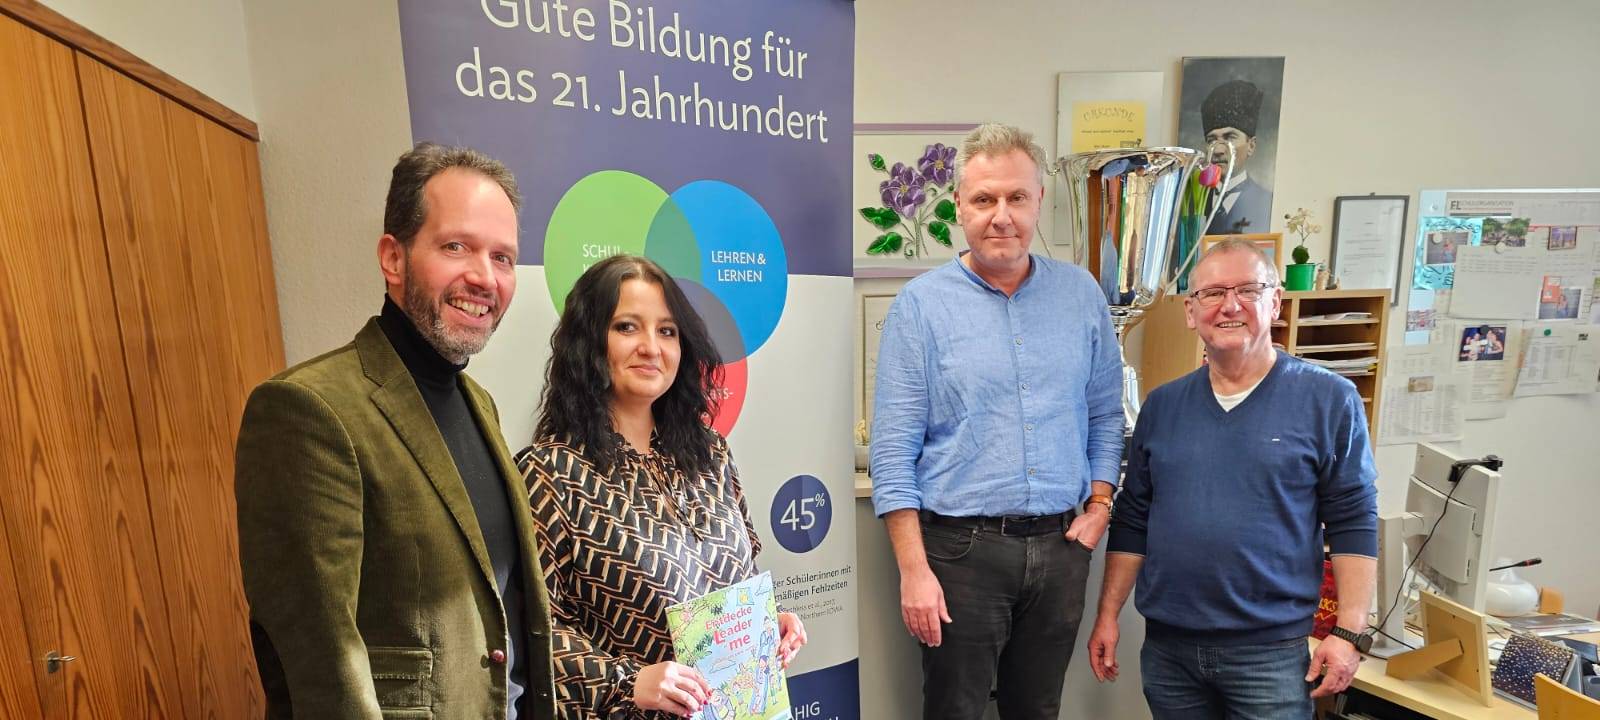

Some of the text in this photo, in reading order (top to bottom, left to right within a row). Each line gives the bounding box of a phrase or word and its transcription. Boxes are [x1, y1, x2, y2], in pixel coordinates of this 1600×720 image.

[480, 0, 808, 82] Gute Bildung für
[455, 46, 829, 143] das 21. Jahrhundert
[711, 250, 767, 265] LEHREN &
[718, 268, 763, 283] LERNEN
[840, 564, 851, 575] mit
[811, 580, 848, 595] Fehlzeiten
[705, 606, 752, 631] Entdecke
[713, 619, 752, 645] Leader
[729, 634, 750, 651] me
